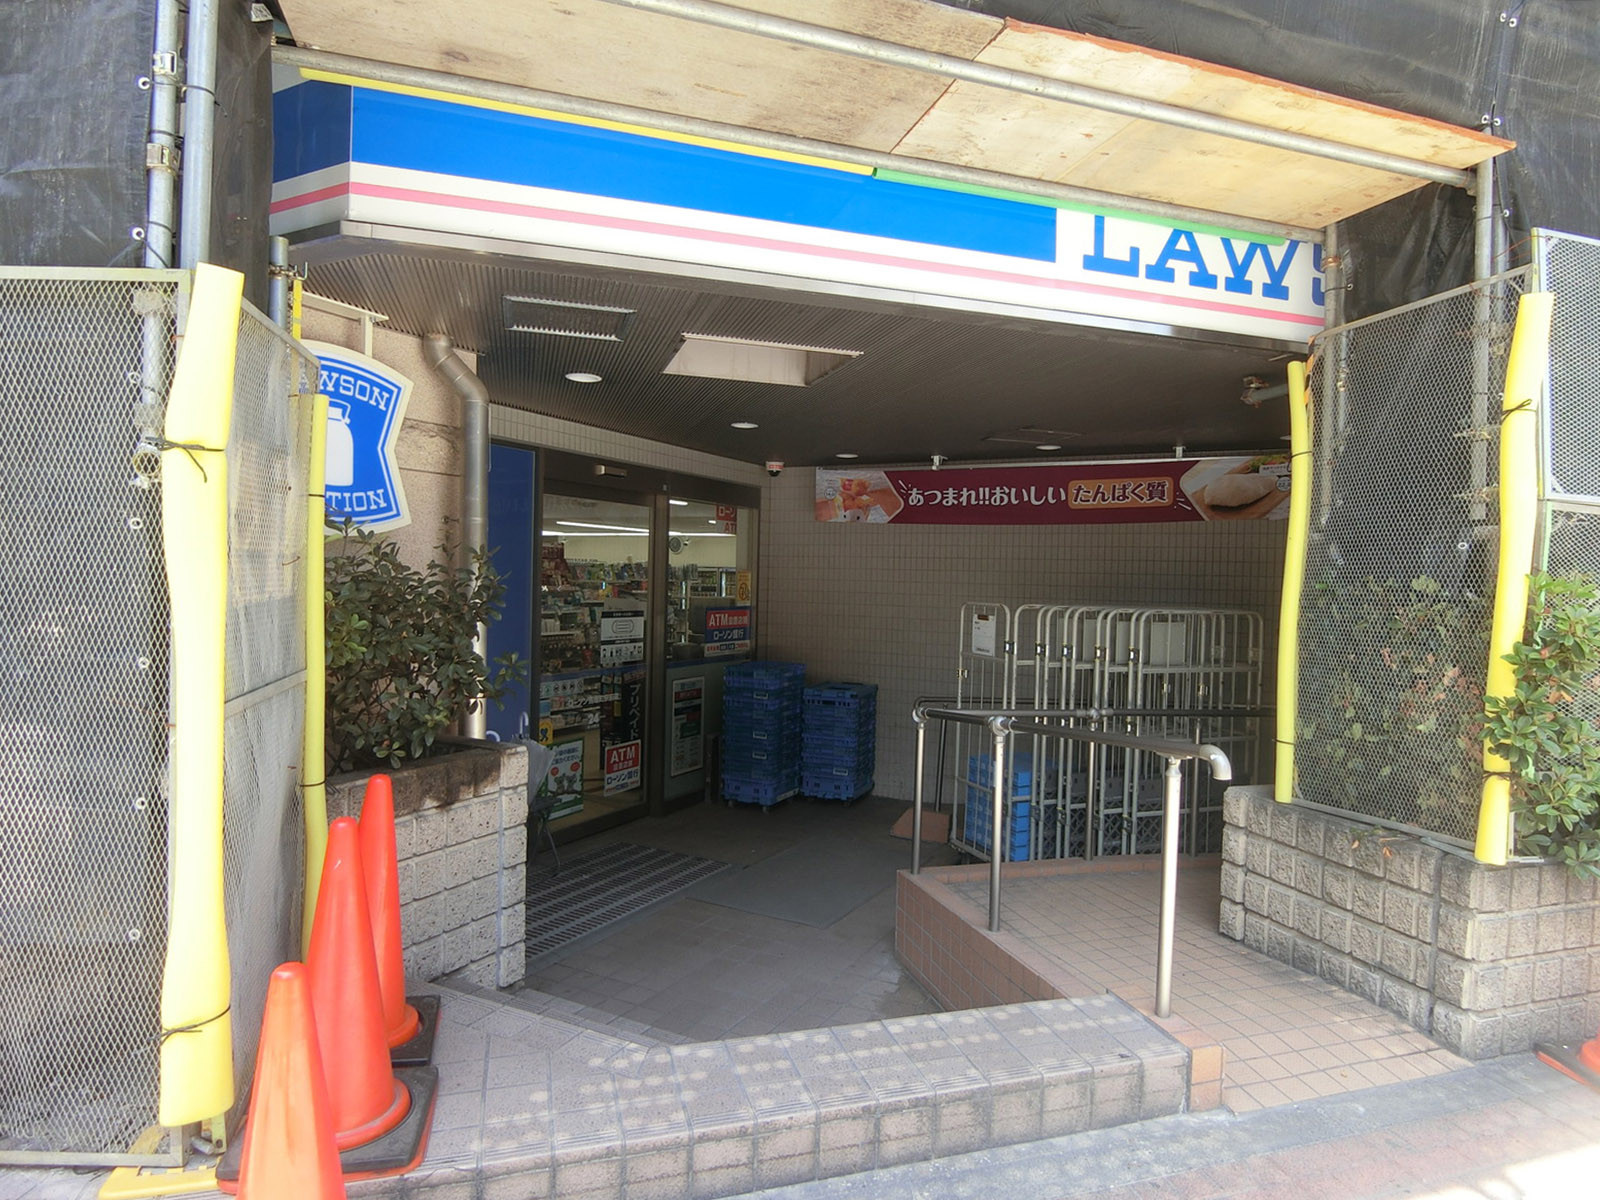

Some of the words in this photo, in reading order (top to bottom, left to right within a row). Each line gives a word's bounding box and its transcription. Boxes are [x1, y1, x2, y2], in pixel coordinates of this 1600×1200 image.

[1082, 214, 1325, 306] LAW
[1072, 480, 1169, 505] たんぱく質
[708, 613, 728, 627] ATM
[610, 746, 636, 764] ATM
